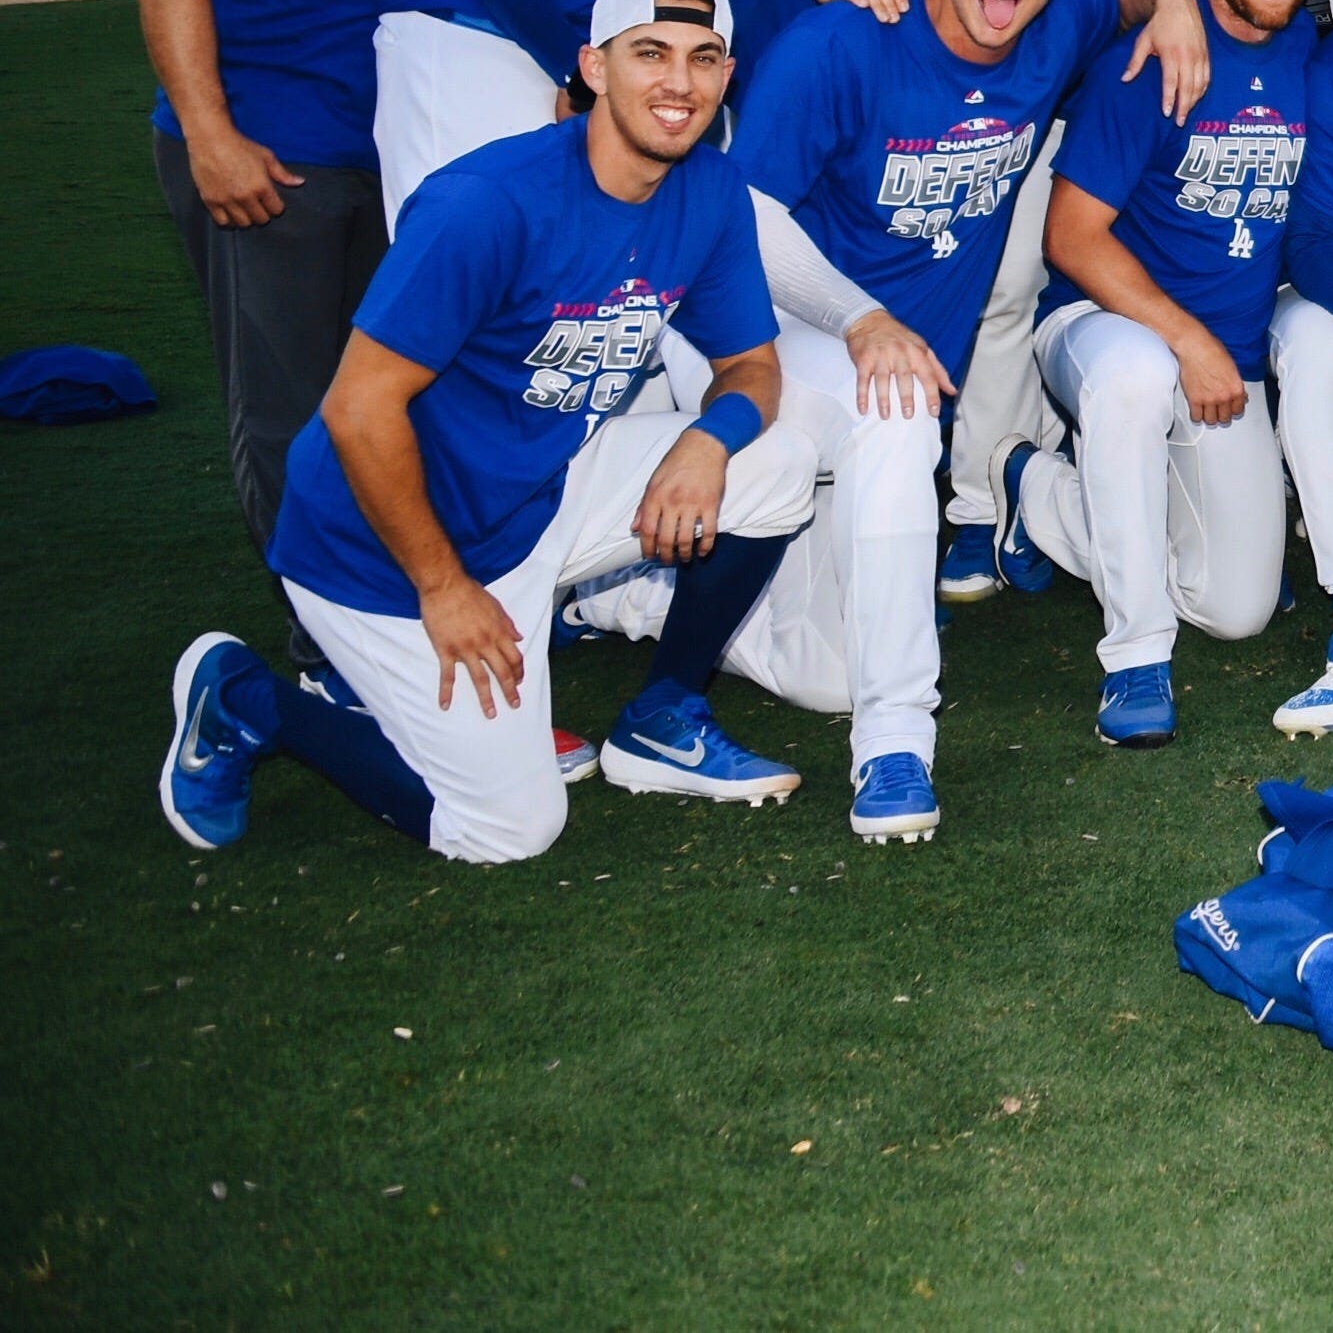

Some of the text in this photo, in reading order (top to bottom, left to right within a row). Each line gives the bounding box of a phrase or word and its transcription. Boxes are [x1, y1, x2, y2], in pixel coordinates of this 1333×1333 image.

[935, 130, 1015, 153] CHAMPIONS
[1228, 122, 1288, 134] CHAMPIONS
[1174, 134, 1308, 186] DEFEN
[1175, 182, 1290, 222] SO CA
[887, 208, 955, 240] SO
[1228, 217, 1254, 259] LA
